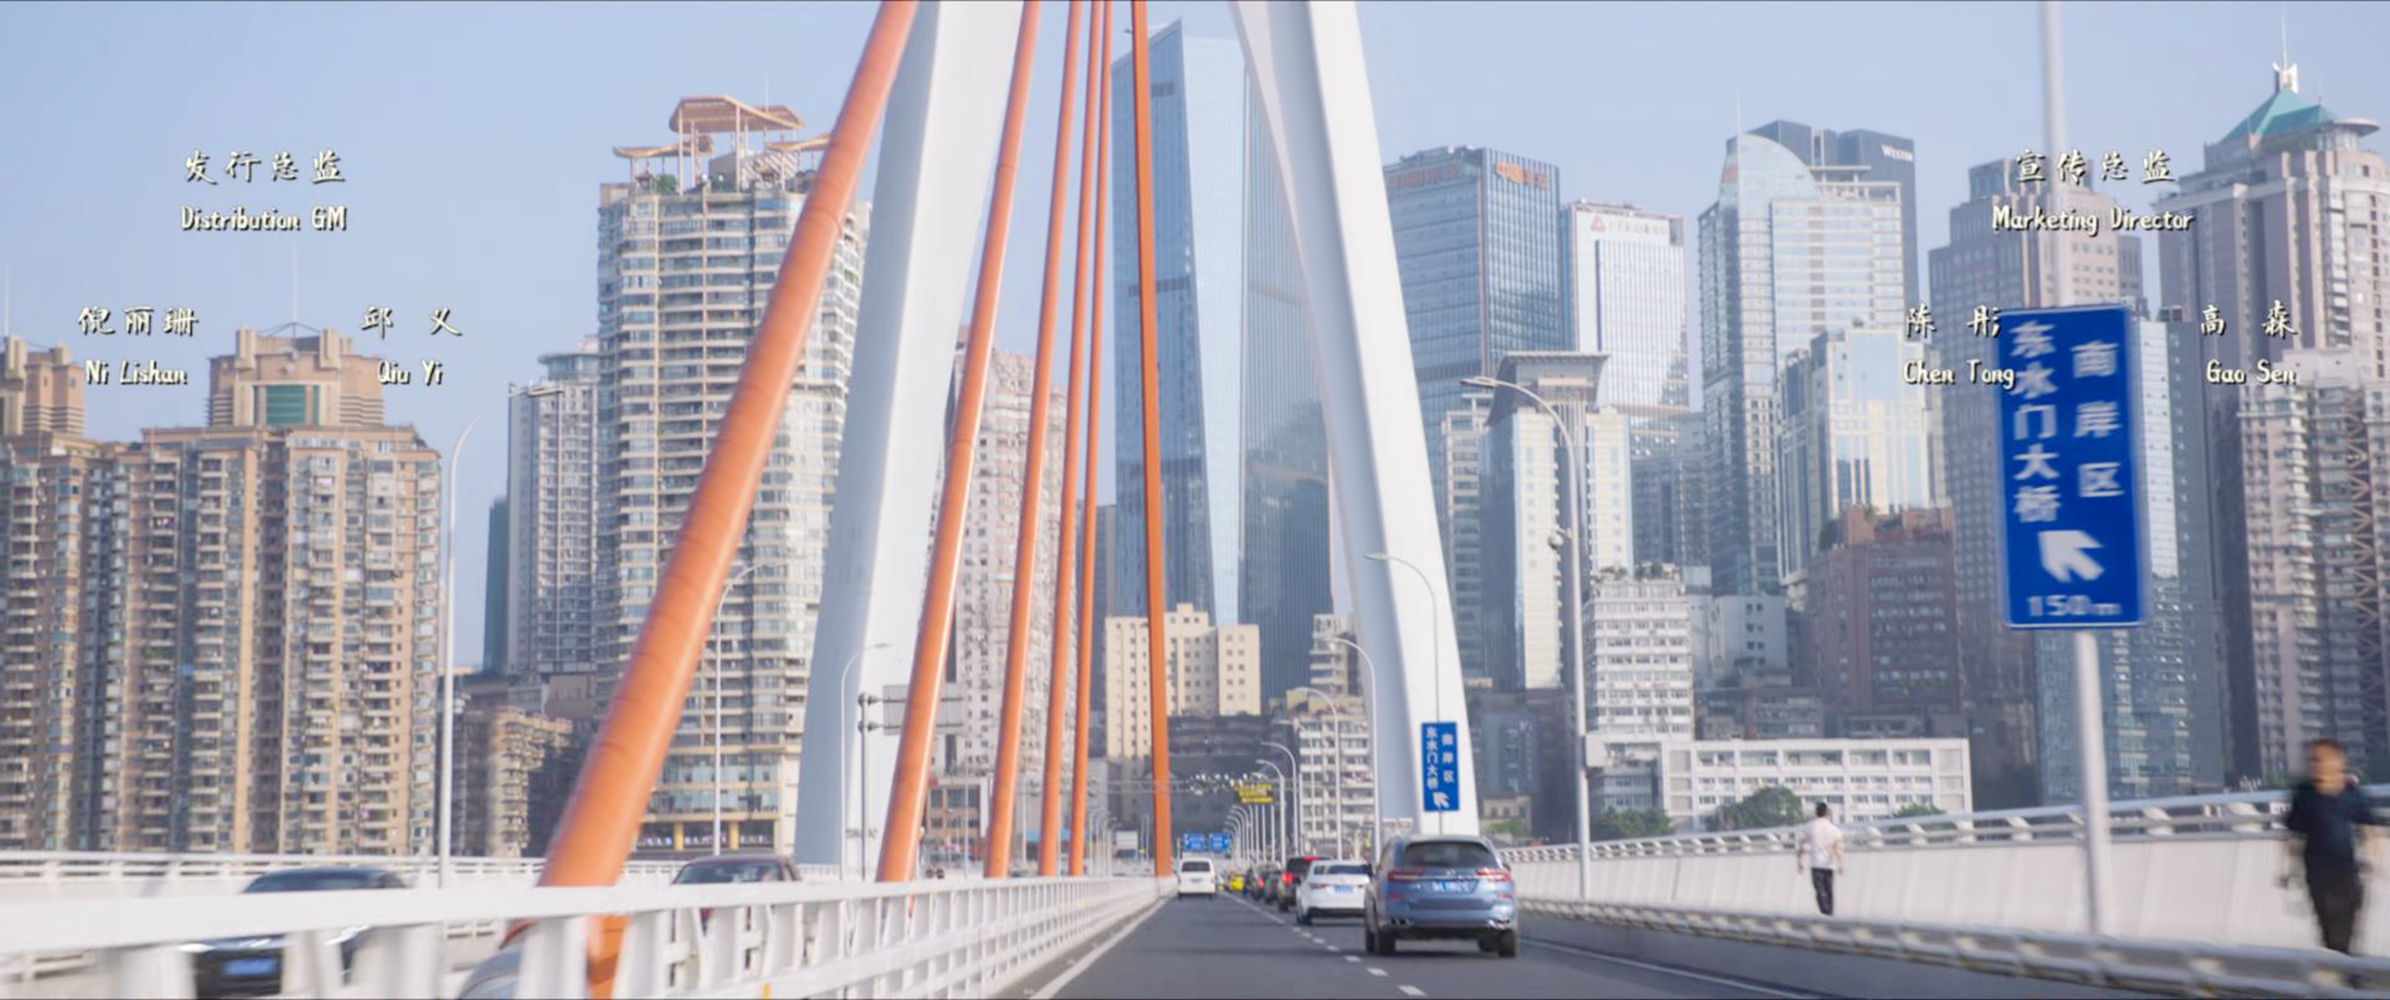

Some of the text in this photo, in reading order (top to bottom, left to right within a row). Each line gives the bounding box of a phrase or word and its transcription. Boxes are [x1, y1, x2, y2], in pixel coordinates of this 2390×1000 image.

[2009, 320, 2062, 524] 东水门大桥
[2068, 339, 2126, 498] 南岸区
[2027, 595, 2122, 617] 150m
